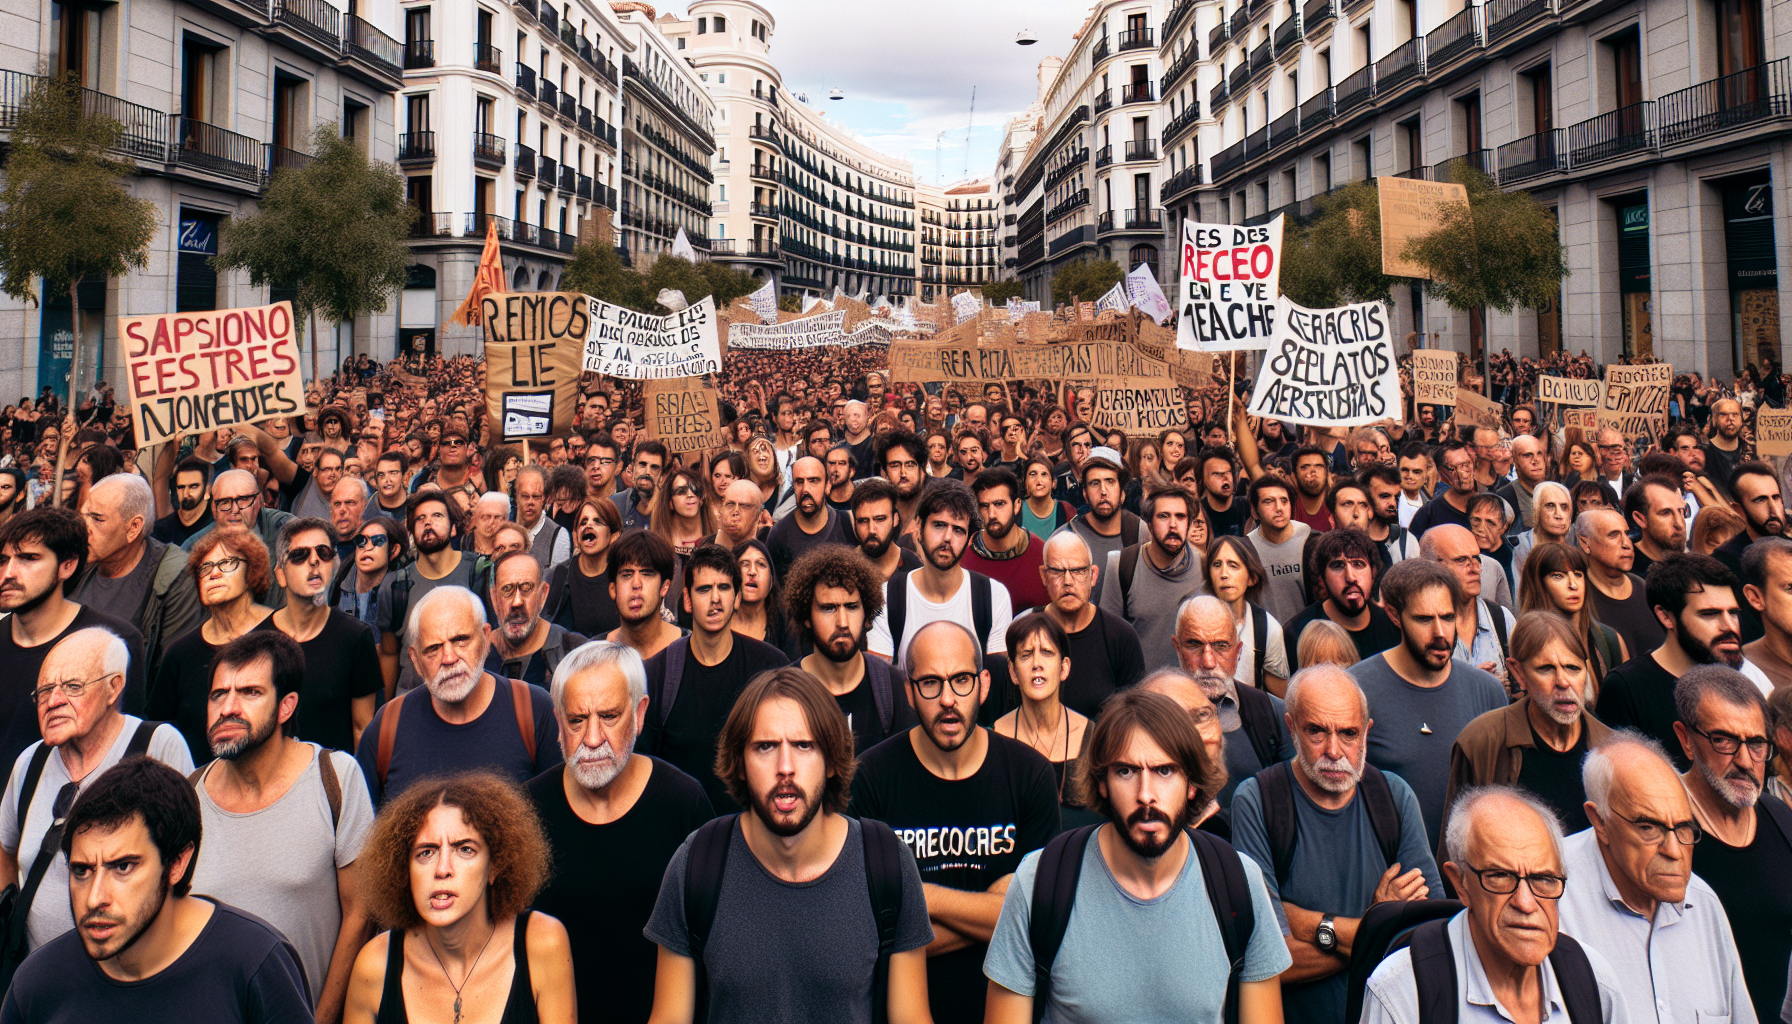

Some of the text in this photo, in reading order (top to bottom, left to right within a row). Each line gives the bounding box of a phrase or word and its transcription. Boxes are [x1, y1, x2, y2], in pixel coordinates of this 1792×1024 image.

[1183, 243, 1274, 282] RECEO
[1241, 282, 1268, 300] VE
[126, 305, 290, 358] SAPSIONO
[131, 339, 296, 398] EESTRES
[512, 343, 555, 387] LIE
